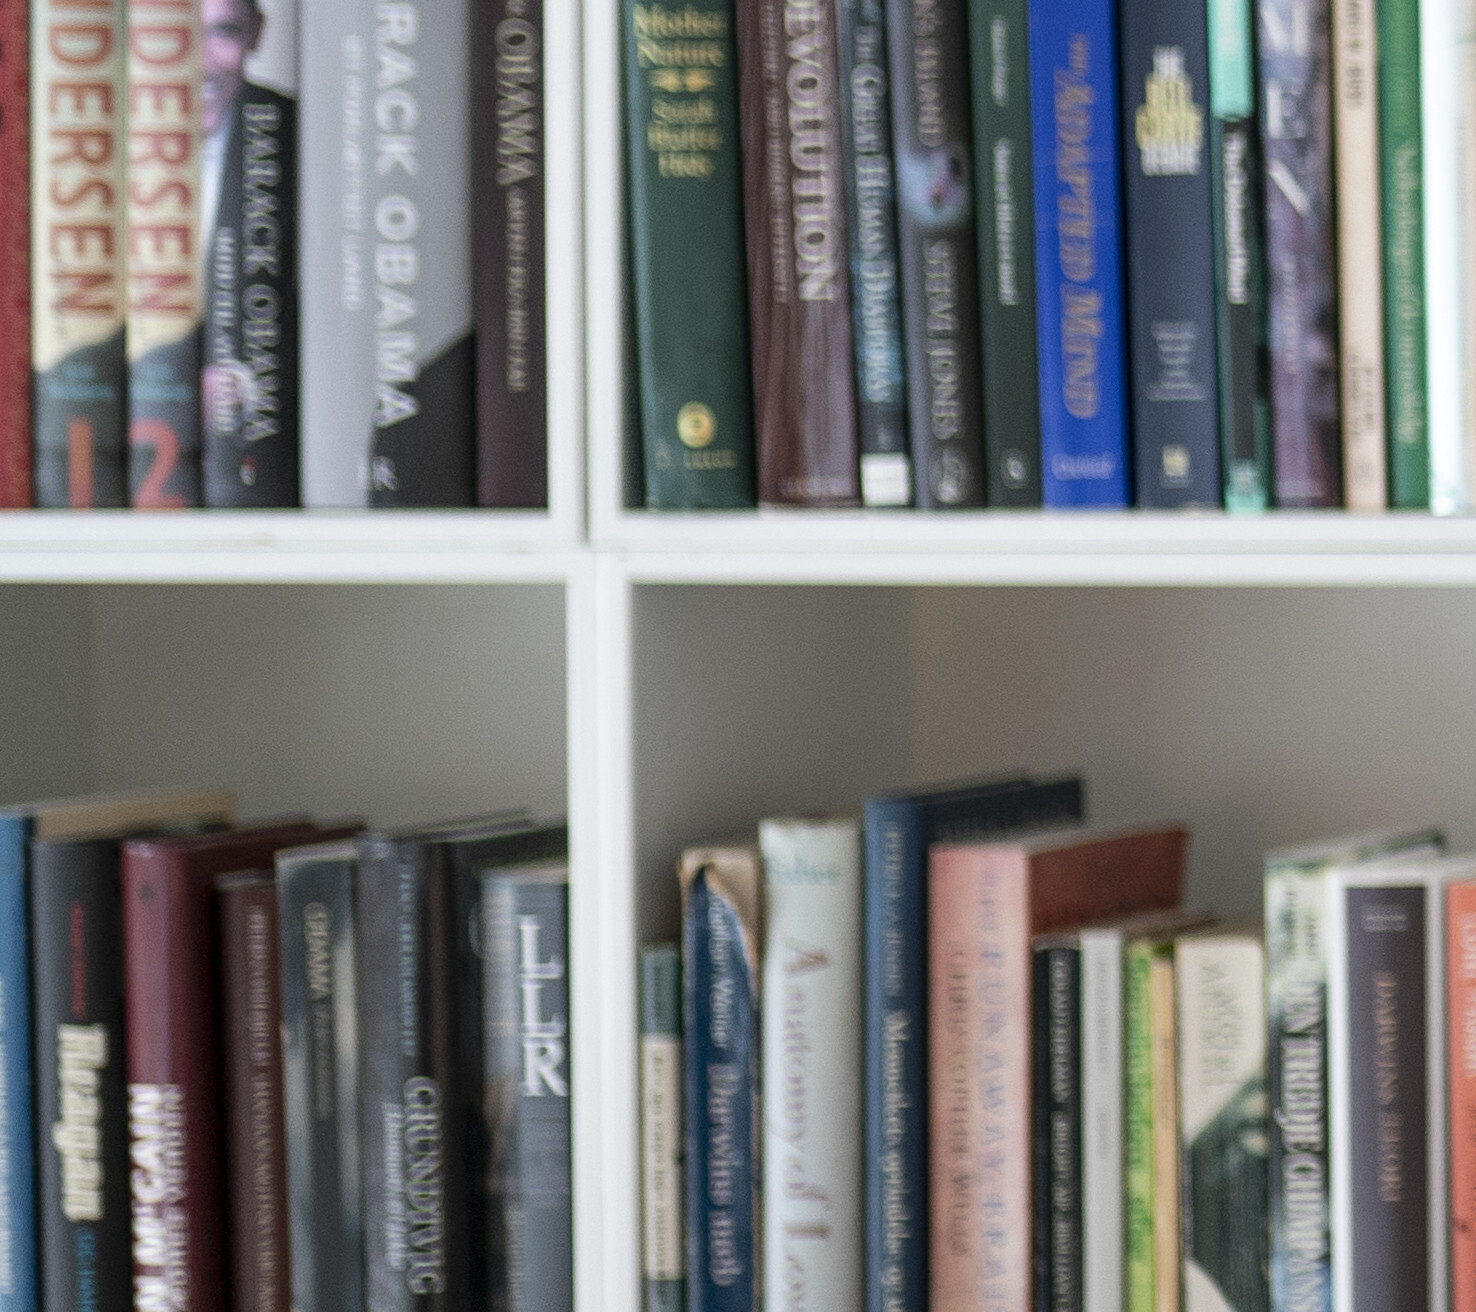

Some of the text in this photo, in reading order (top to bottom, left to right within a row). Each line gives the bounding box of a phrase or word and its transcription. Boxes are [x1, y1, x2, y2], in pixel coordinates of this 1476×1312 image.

[240, 101, 282, 442] BARACK OBAMA
[374, 196, 420, 427] OBAMA
[69, 417, 94, 509] 1
[52, 1024, 110, 1222] Reagan
[771, 937, 832, 1144] Anatomy
[787, 1155, 828, 1202] of
